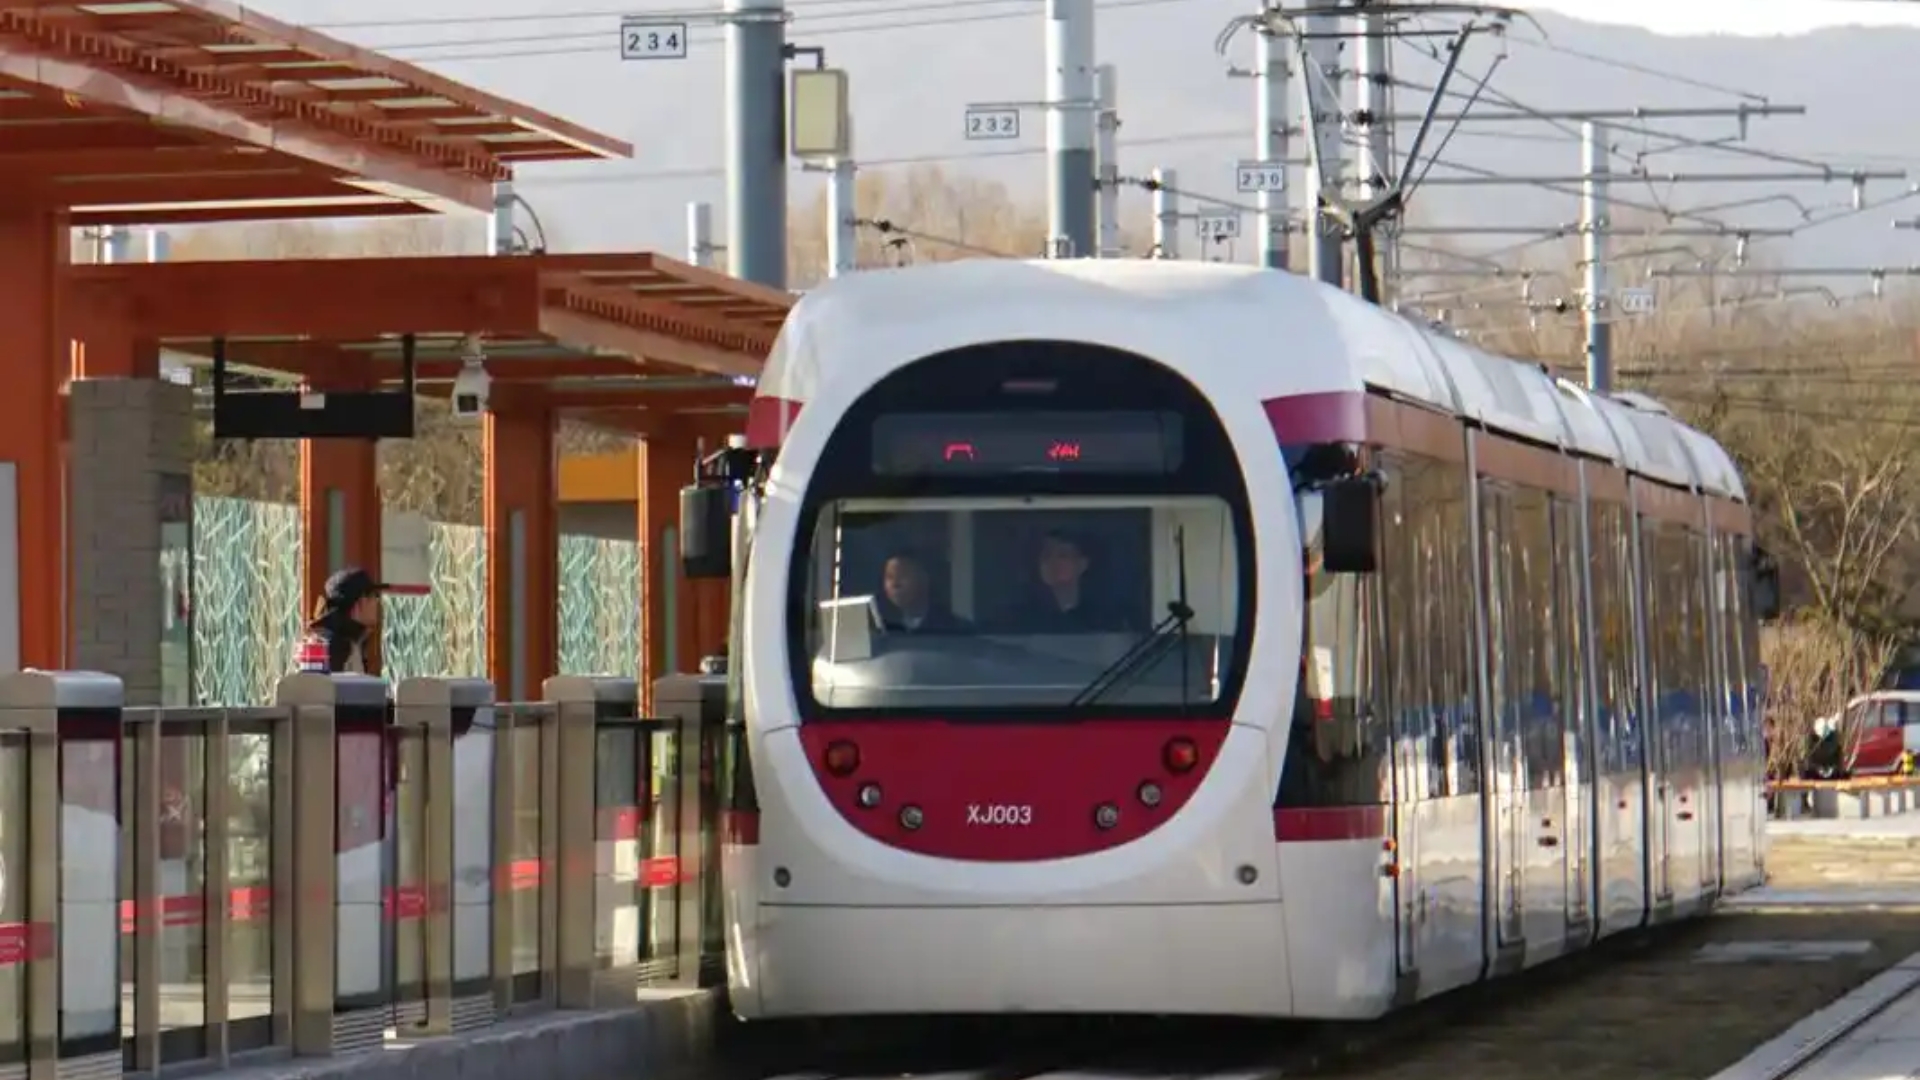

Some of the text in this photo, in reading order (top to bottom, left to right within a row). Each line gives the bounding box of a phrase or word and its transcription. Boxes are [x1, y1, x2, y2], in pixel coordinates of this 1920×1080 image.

[628, 31, 679, 51] 234
[971, 116, 1013, 132] 232
[967, 804, 1031, 824] XJ003
